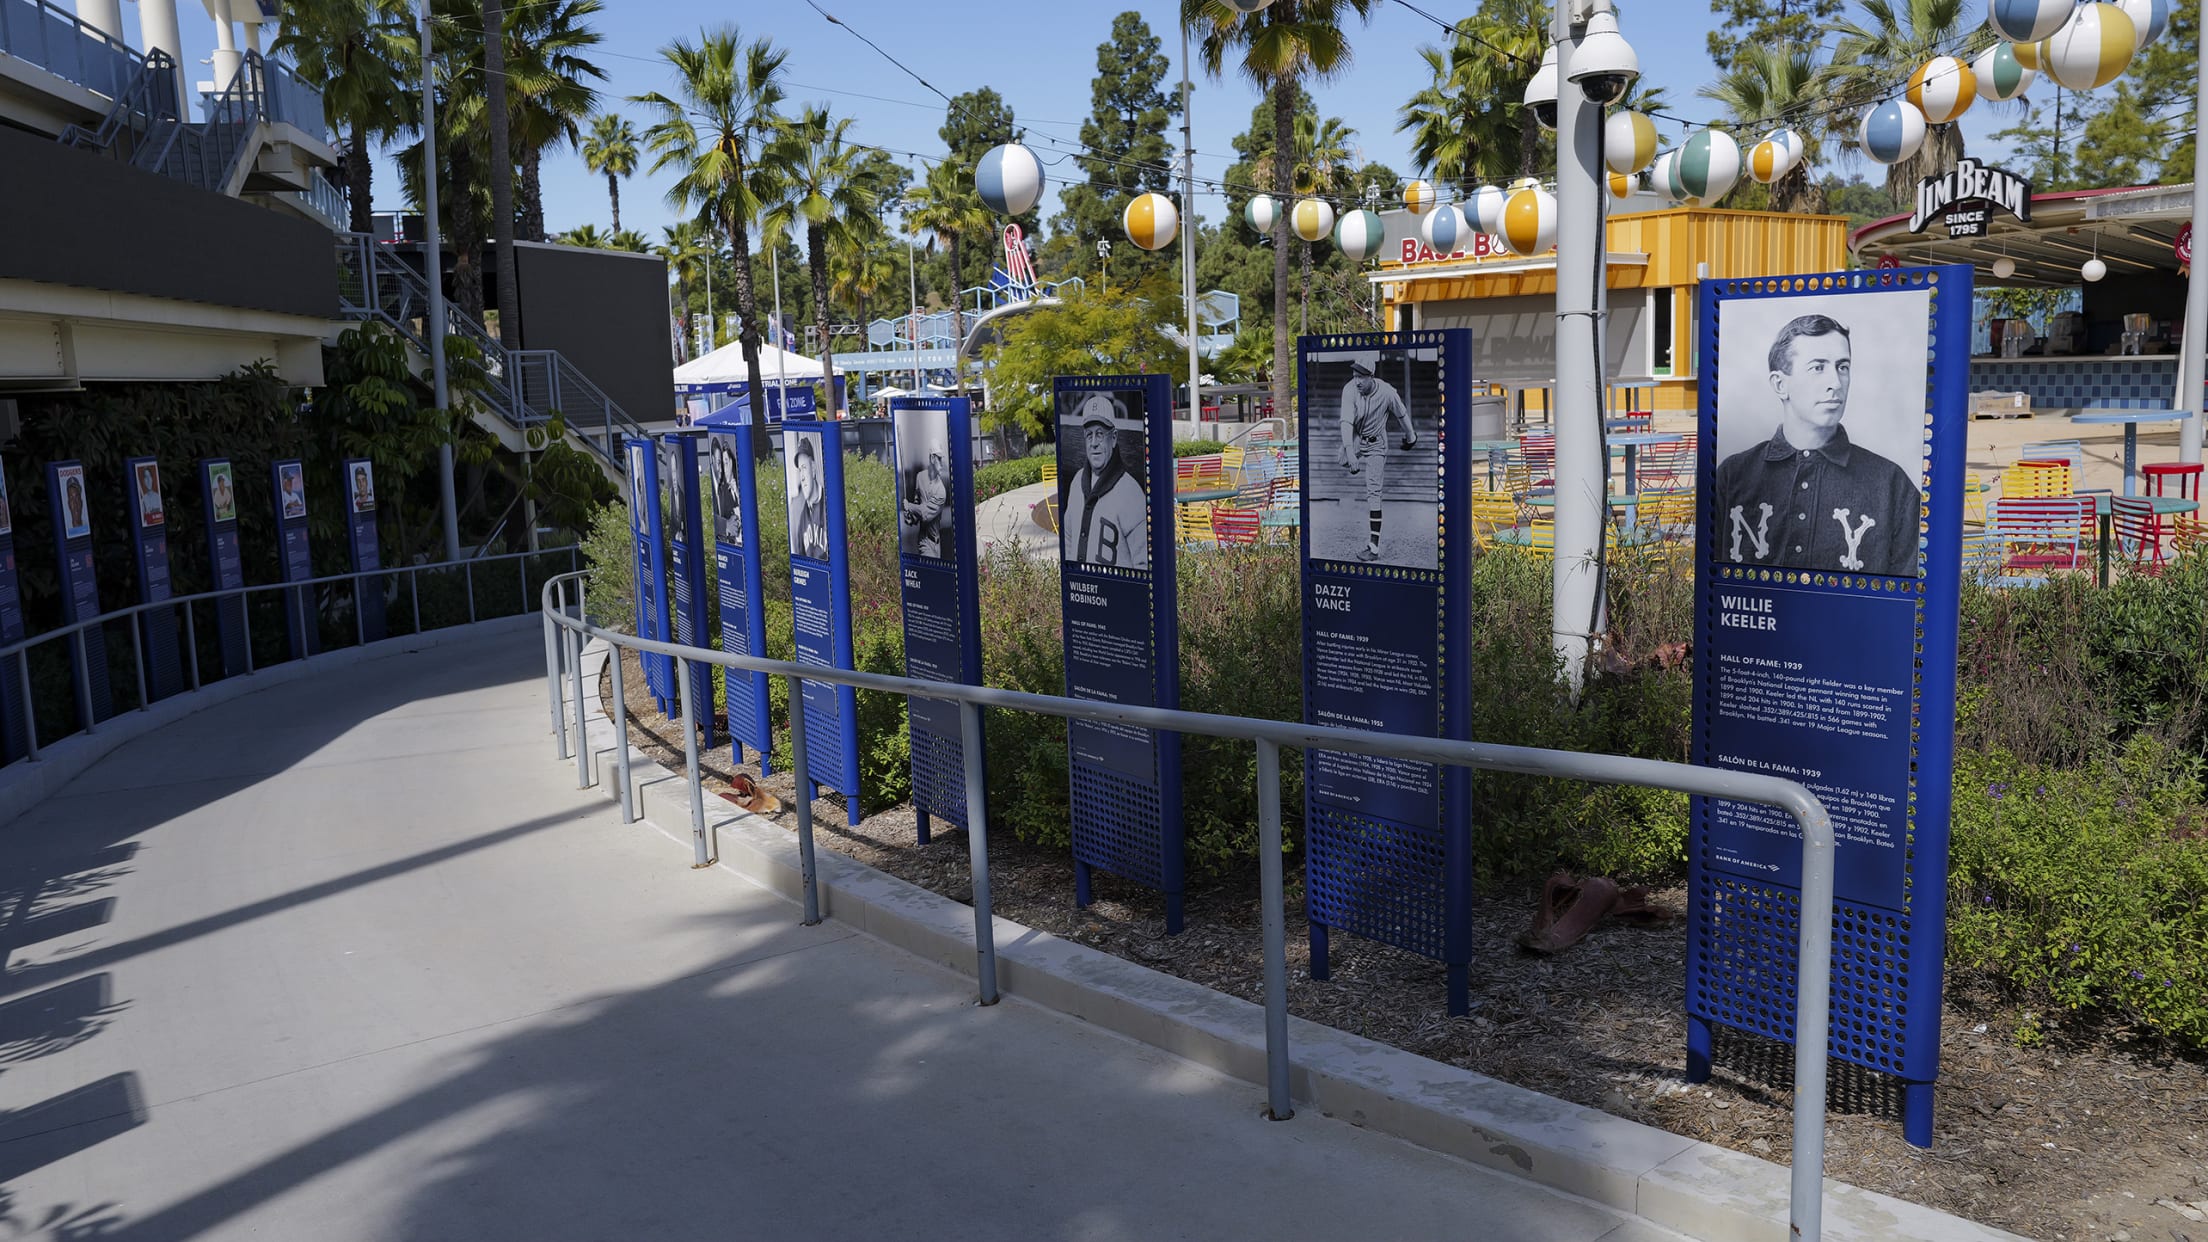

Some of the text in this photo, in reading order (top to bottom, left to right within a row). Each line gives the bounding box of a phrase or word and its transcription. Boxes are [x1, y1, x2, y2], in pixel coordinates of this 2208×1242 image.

[1909, 158, 2024, 233] JIM BEAM
[1945, 211, 1984, 225] SINCE
[1949, 224, 1978, 236] 1795
[761, 379, 780, 388] TRIAL
[790, 396, 807, 408] ZONE
[59, 468, 82, 478] DODGERS
[1095, 516, 1119, 567] B
[1728, 503, 1876, 571] N Y
[904, 569, 917, 580] ZACK
[905, 579, 921, 589] WHEAT
[1069, 581, 1098, 594] WILBERT
[1315, 584, 1351, 598] DAZZY
[1070, 593, 1107, 608] ROBINSON
[1315, 597, 1351, 612] VANCE
[1721, 595, 1772, 612] WILLIE
[1720, 612, 1776, 630] KEELER
[1720, 654, 1802, 670] HALL OF FAME: 1939
[1727, 676, 1755, 685] Brooklyn's
[1757, 680, 1782, 688] National
[1784, 683, 1806, 693] League
[1807, 686, 1832, 697] pennant
[1834, 690, 1858, 700] winning
[1772, 672, 1804, 683] 140-pound
[1806, 677, 1820, 686] right
[1822, 678, 1841, 687] fielder
[1876, 687, 1903, 695] member
[1720, 691, 1733, 699] 1899
[1748, 695, 1759, 703] 204
[1780, 699, 1796, 708] 1900.
[1806, 703, 1820, 711] 1893
[1853, 709, 1886, 720] 1899-1902,
[1748, 687, 1764, 695] 1900.
[1765, 689, 1784, 697] Keeler
[1818, 696, 1832, 704] with
[1834, 698, 1845, 706] 140
[1862, 703, 1883, 711] scored
[1719, 700, 1736, 708] Keeler
[1739, 702, 1760, 712] slashed
[1827, 715, 1839, 723] 566
[1841, 718, 1861, 727] games
[1863, 720, 1877, 728] with
[1719, 708, 1744, 718] Brooklyn.
[1757, 714, 1776, 723] batted
[1778, 716, 1789, 724] .341
[1816, 723, 1835, 731] Major
[1837, 726, 1860, 737] League
[1862, 730, 1888, 739] seasons.
[1718, 754, 1821, 778] SALÓN DE LA FAMA: 1939
